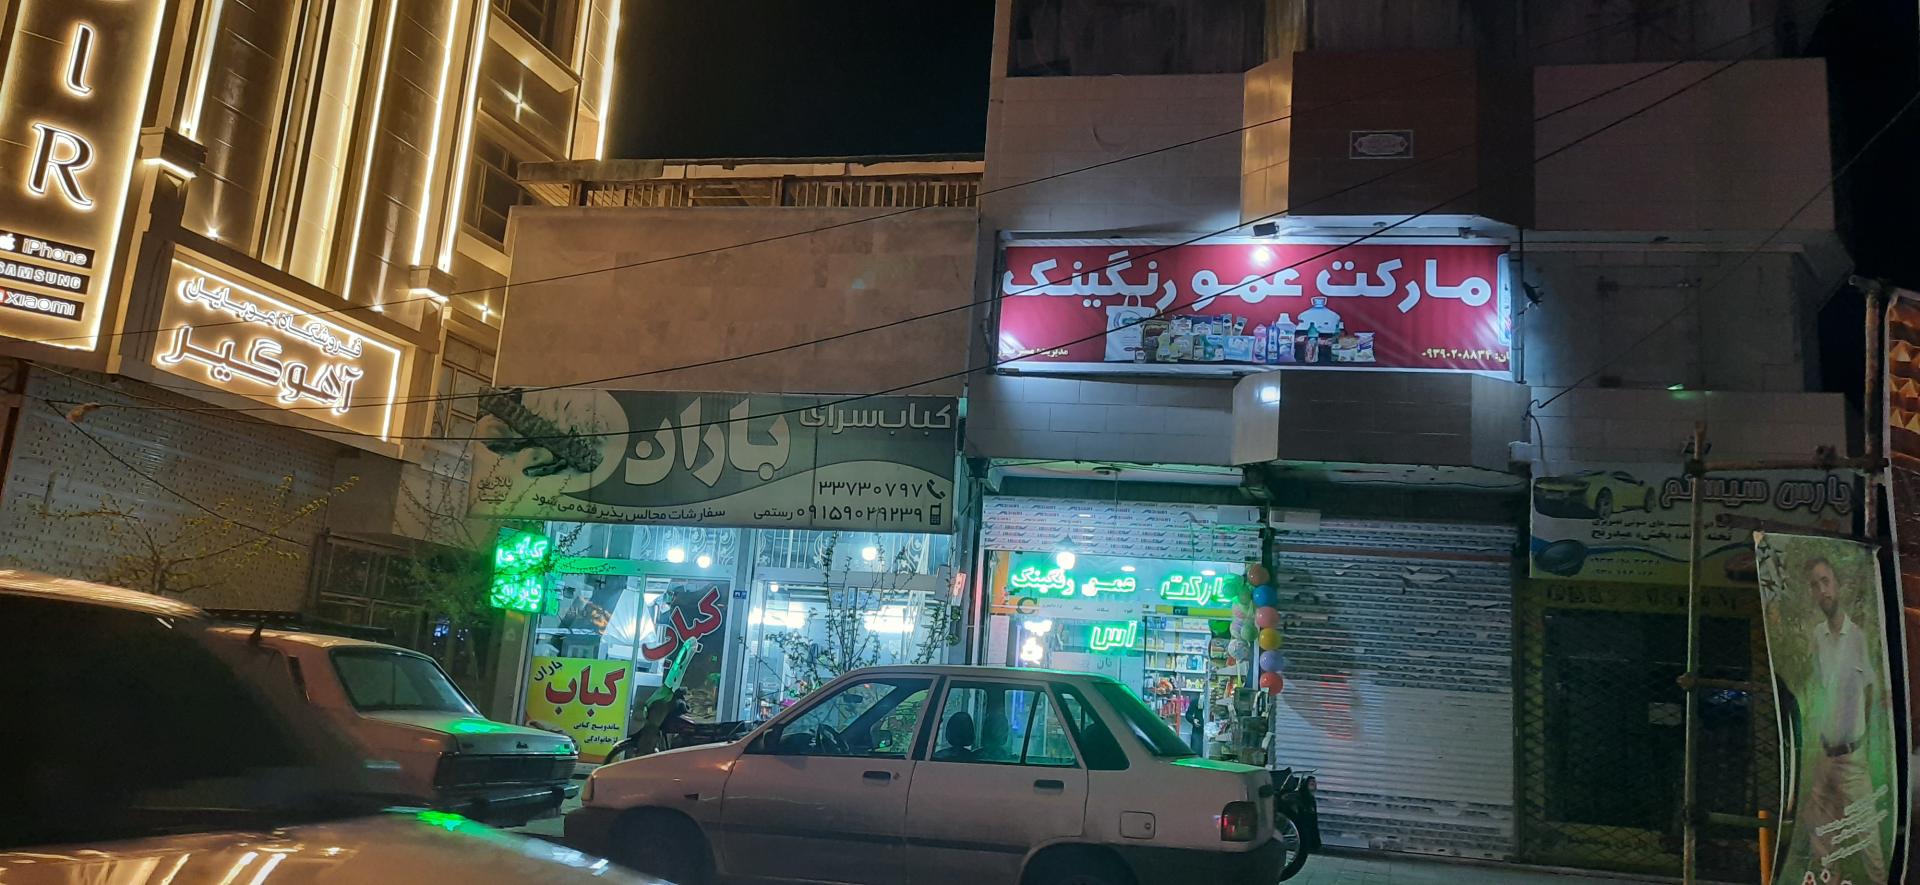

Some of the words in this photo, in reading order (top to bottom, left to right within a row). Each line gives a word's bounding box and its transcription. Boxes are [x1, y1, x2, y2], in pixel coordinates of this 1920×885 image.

[22, 238, 87, 266] iPhone
[0, 261, 82, 289] SAMSUNG
[1002, 249, 1178, 314] رنگینک
[1190, 265, 1304, 312] عمو
[1316, 258, 1492, 313] مارکت
[182, 277, 277, 325] موبایل
[277, 312, 363, 359] فروشگاه
[160, 325, 364, 413] آهوگیر
[799, 403, 879, 434] سرای
[878, 402, 952, 435] کباب
[622, 395, 791, 489] باران
[819, 480, 923, 498] ۳۳۷۳۰۷۹۷
[1775, 475, 1851, 514] پارس
[577, 503, 624, 520] پذیرفته
[625, 507, 667, 521] مجالس
[668, 506, 726, 522] سفارشات
[753, 508, 795, 523] رستمی
[641, 587, 724, 669] کباب
[534, 660, 563, 681] باران
[545, 665, 626, 717] کباب
